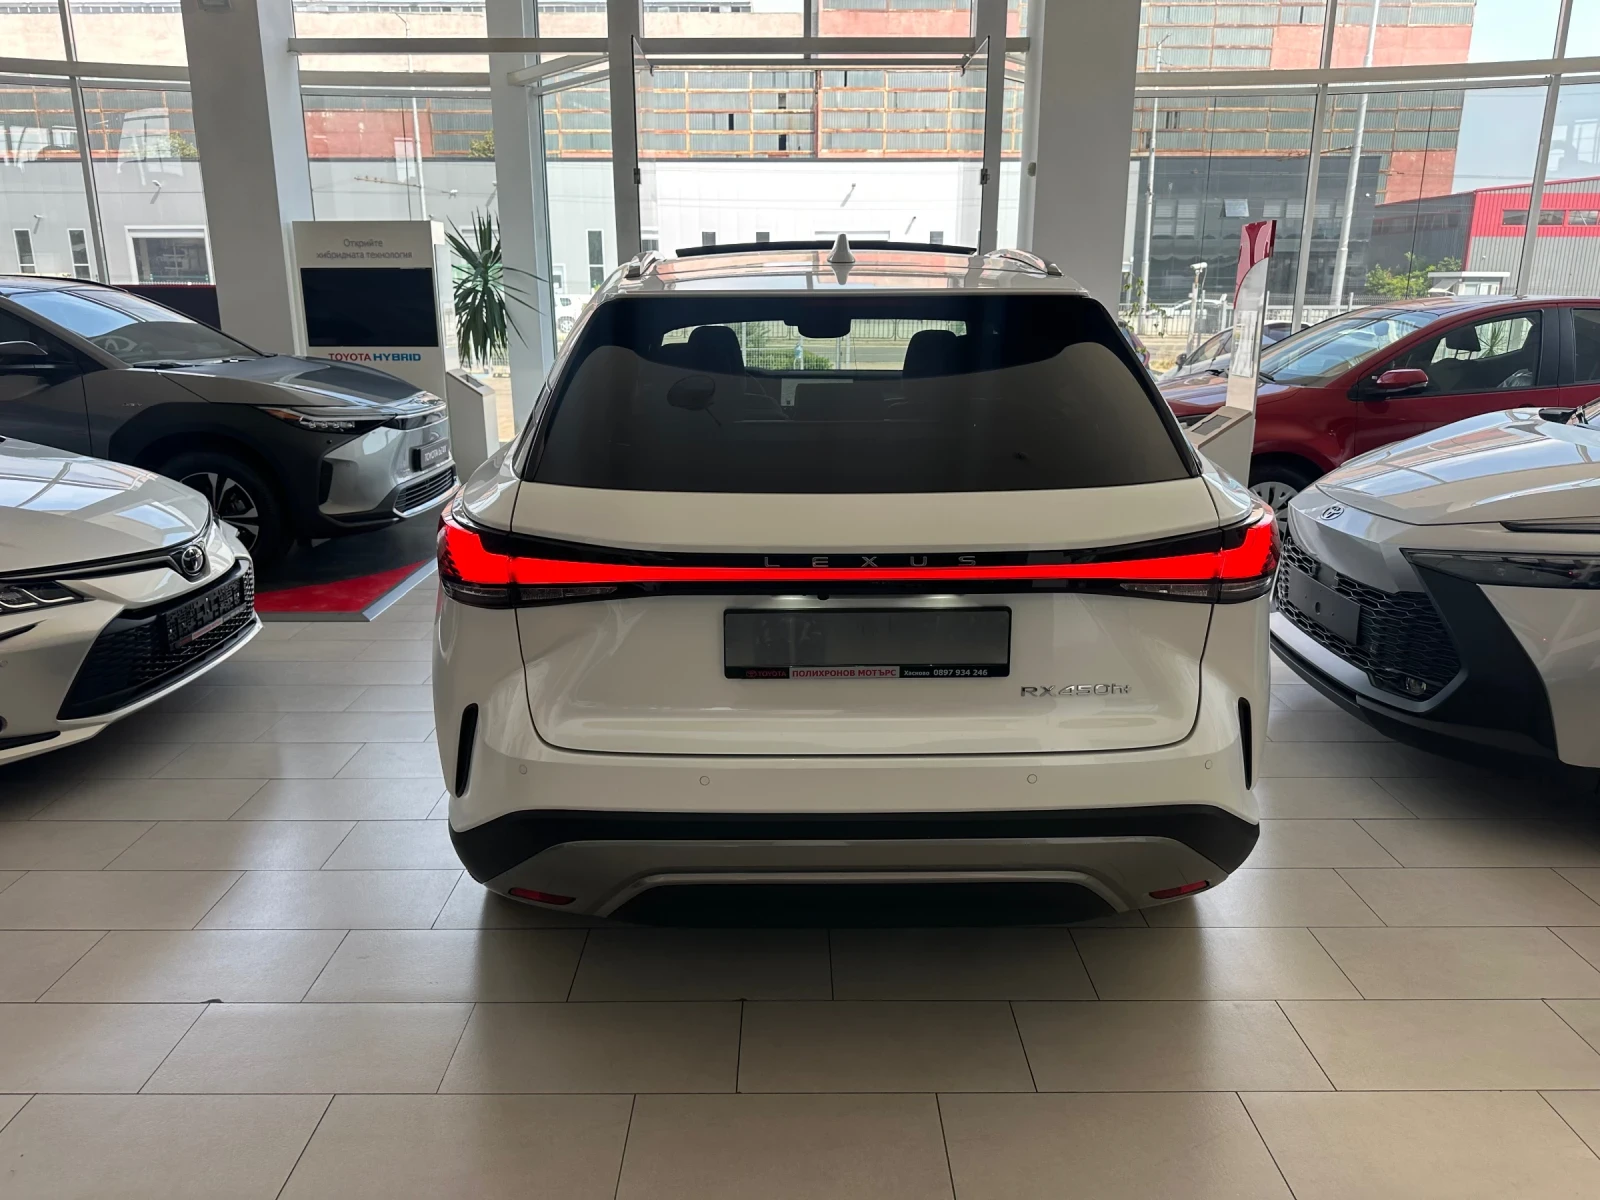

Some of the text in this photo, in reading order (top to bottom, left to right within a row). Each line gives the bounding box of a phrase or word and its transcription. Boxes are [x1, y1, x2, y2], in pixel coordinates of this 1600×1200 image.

[343, 238, 383, 249] Открийте
[316, 250, 413, 260] хибридната технология
[328, 353, 422, 362] TOYOTA HYBRID
[764, 555, 976, 567] LEXUS
[857, 669, 897, 677] МОТЪРС
[933, 668, 954, 677] 0897
[955, 668, 971, 677] 934
[972, 668, 988, 677] 246
